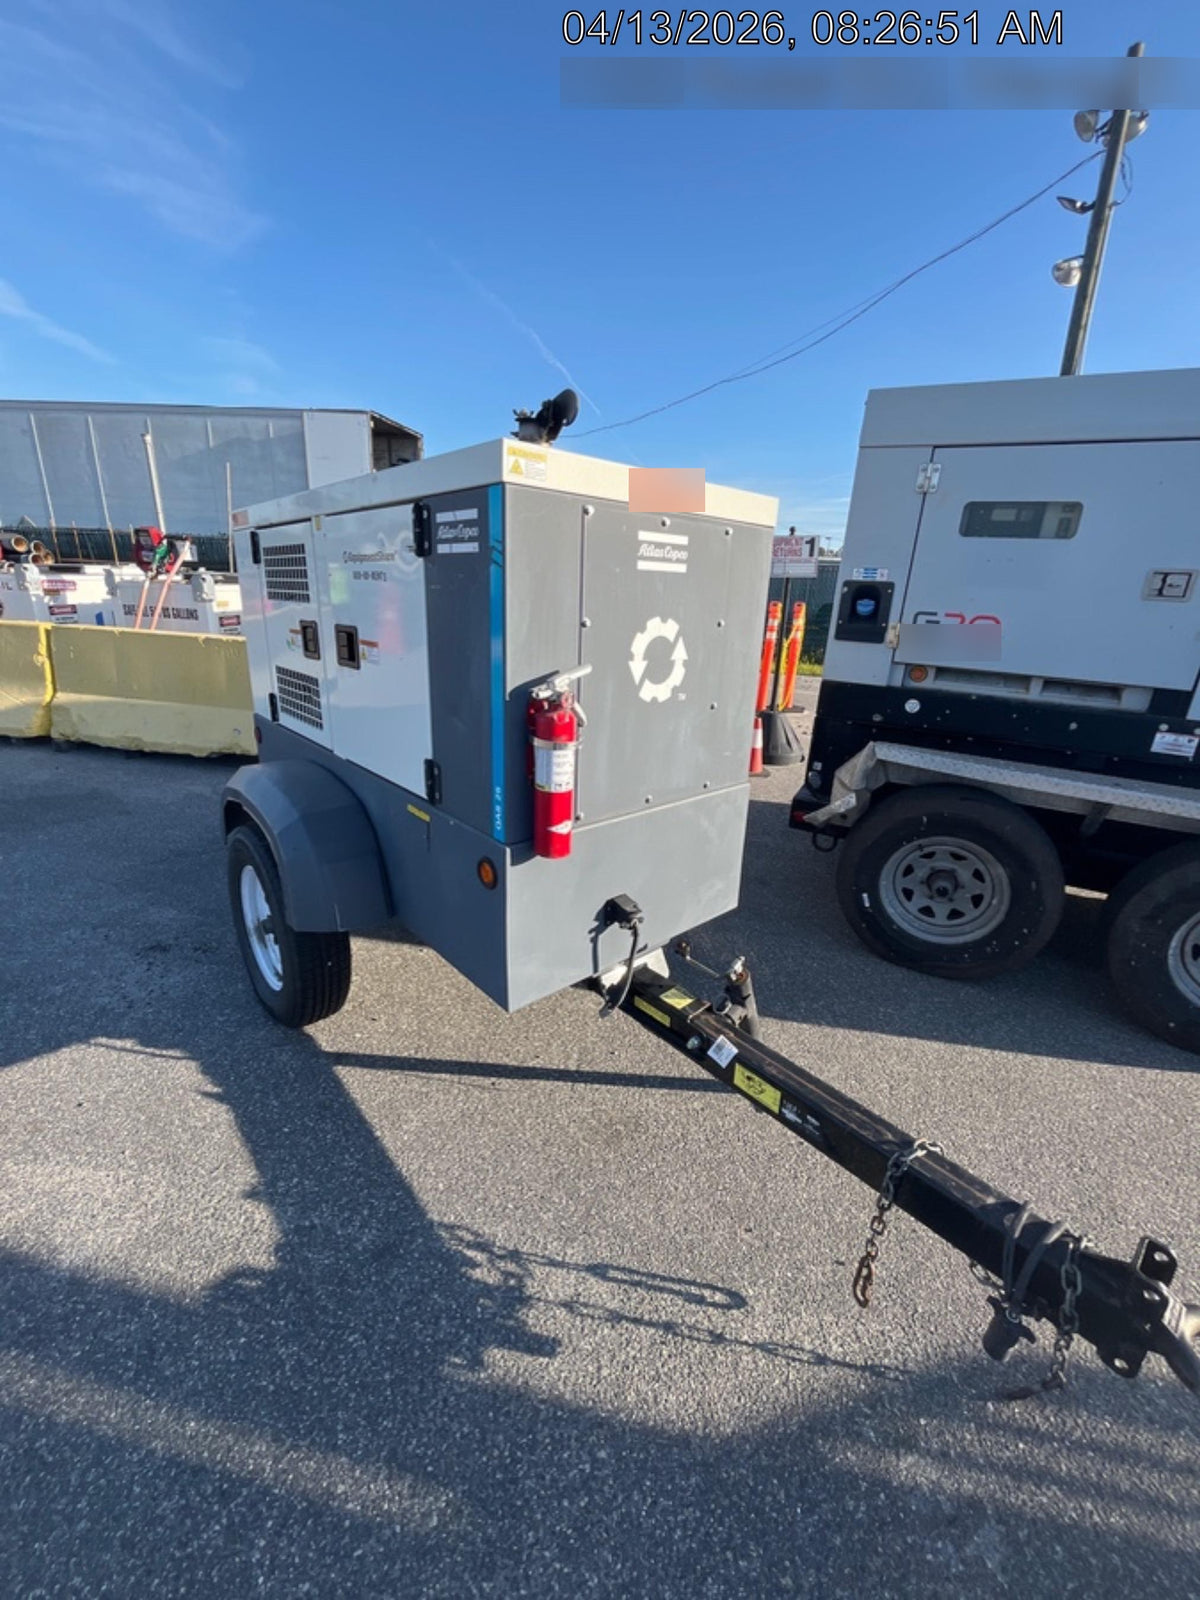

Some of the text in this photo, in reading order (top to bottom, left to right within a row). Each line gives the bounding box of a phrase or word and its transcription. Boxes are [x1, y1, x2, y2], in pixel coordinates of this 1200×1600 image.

[638, 543, 688, 561] Atlas Copco
[805, 537, 815, 557] 1
